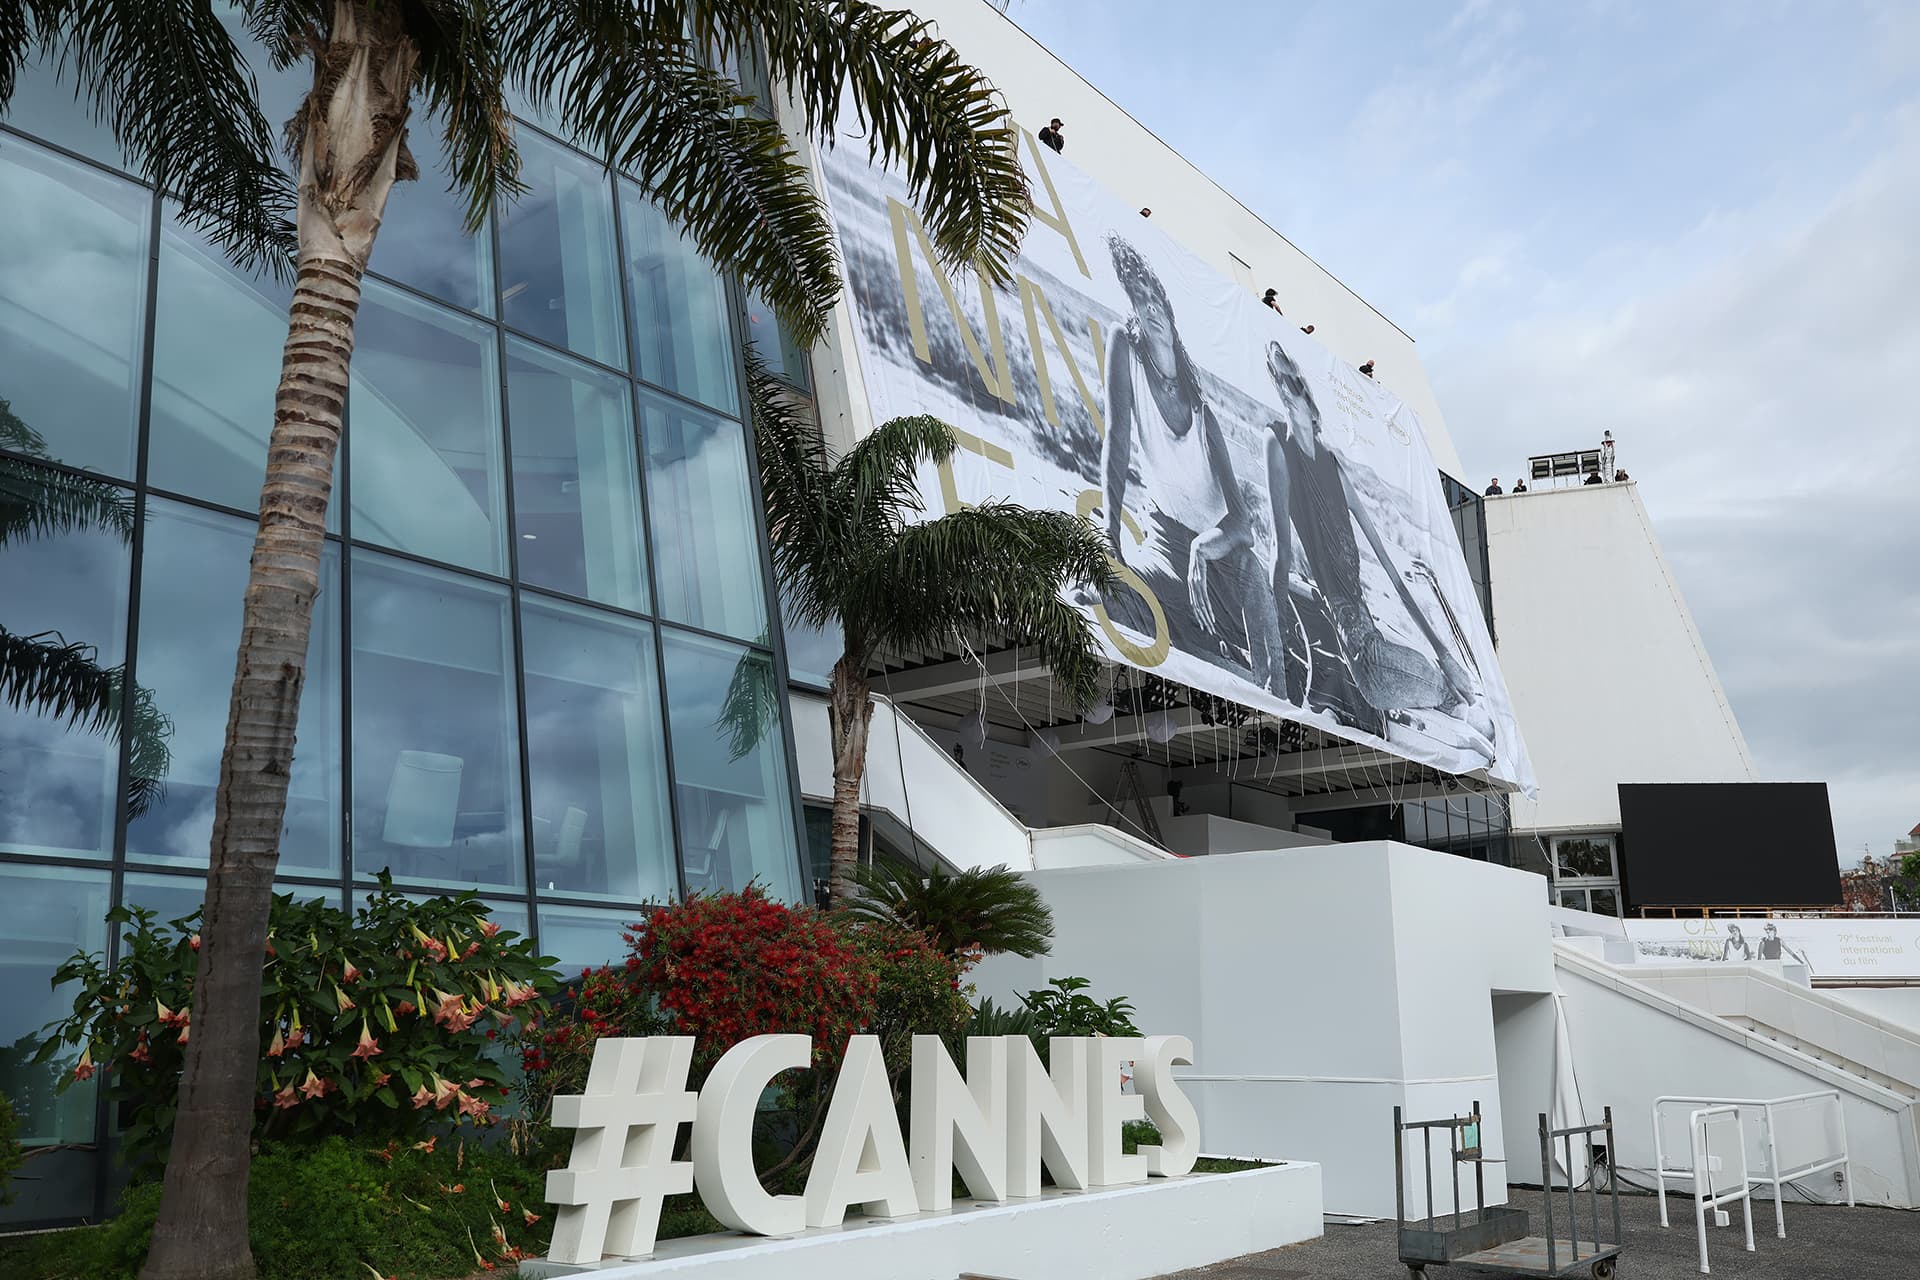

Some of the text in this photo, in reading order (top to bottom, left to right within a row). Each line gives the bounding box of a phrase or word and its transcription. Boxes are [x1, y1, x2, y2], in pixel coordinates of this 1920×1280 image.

[887, 195, 1106, 438] NN
[1683, 919, 1719, 936] CA
[1843, 956, 1856, 966] du
[546, 1034, 1200, 1264] #CANNES
